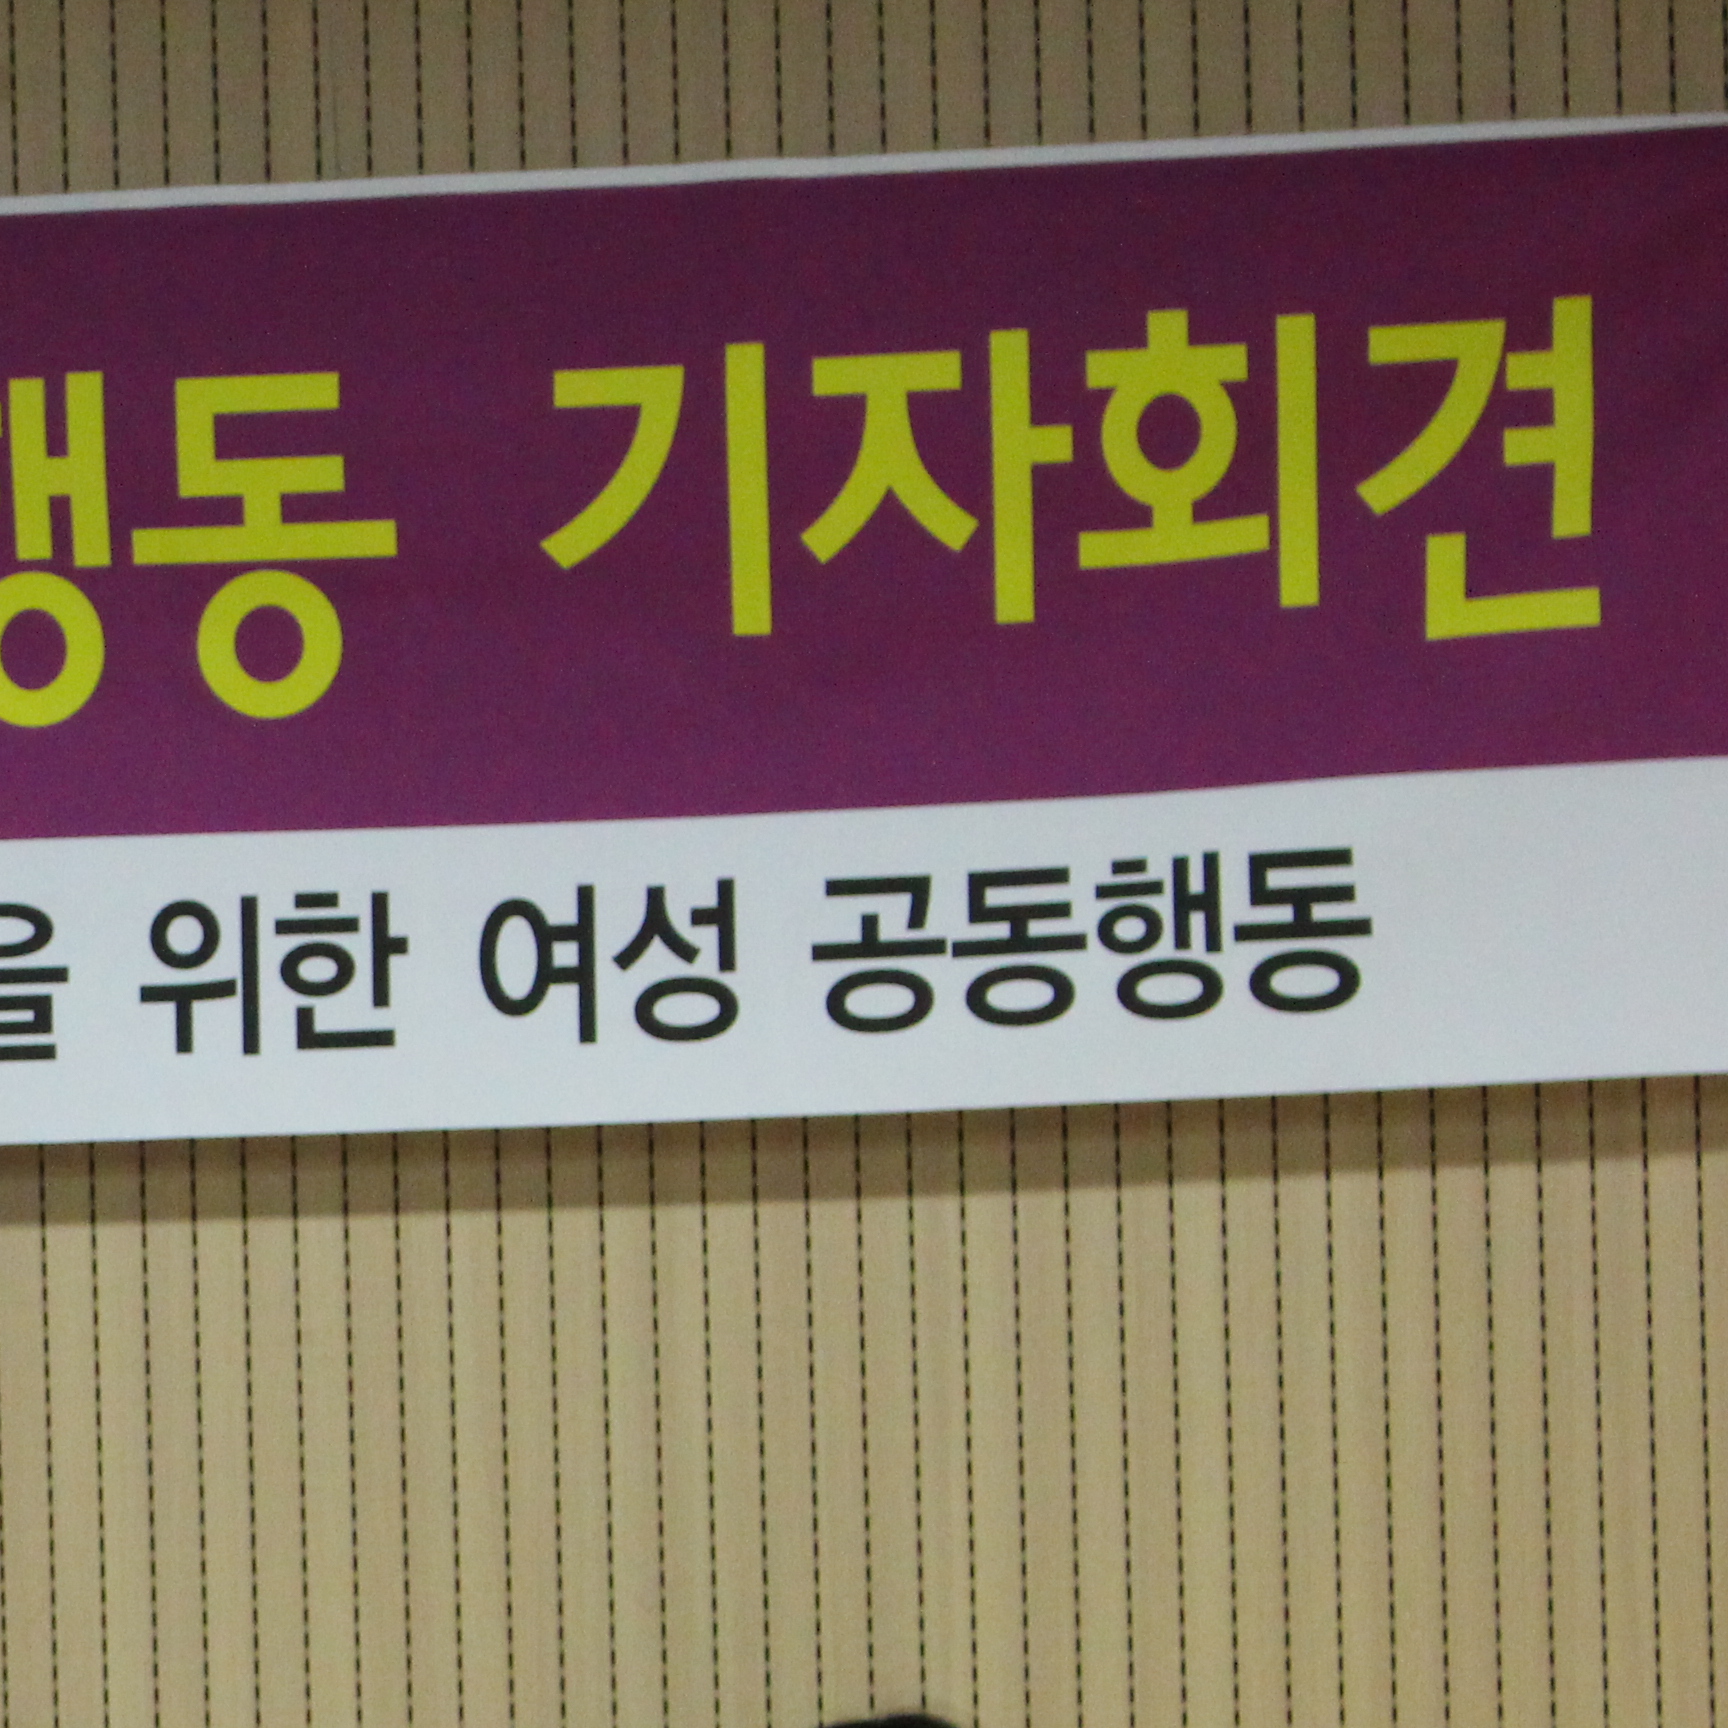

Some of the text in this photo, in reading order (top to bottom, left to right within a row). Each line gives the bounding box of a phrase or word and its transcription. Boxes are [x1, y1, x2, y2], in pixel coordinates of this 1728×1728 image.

[542, 297, 1600, 638] 기자회견
[140, 892, 408, 1055] 위한
[479, 878, 738, 1043] 여성
[812, 848, 1372, 1033] 공동행동
